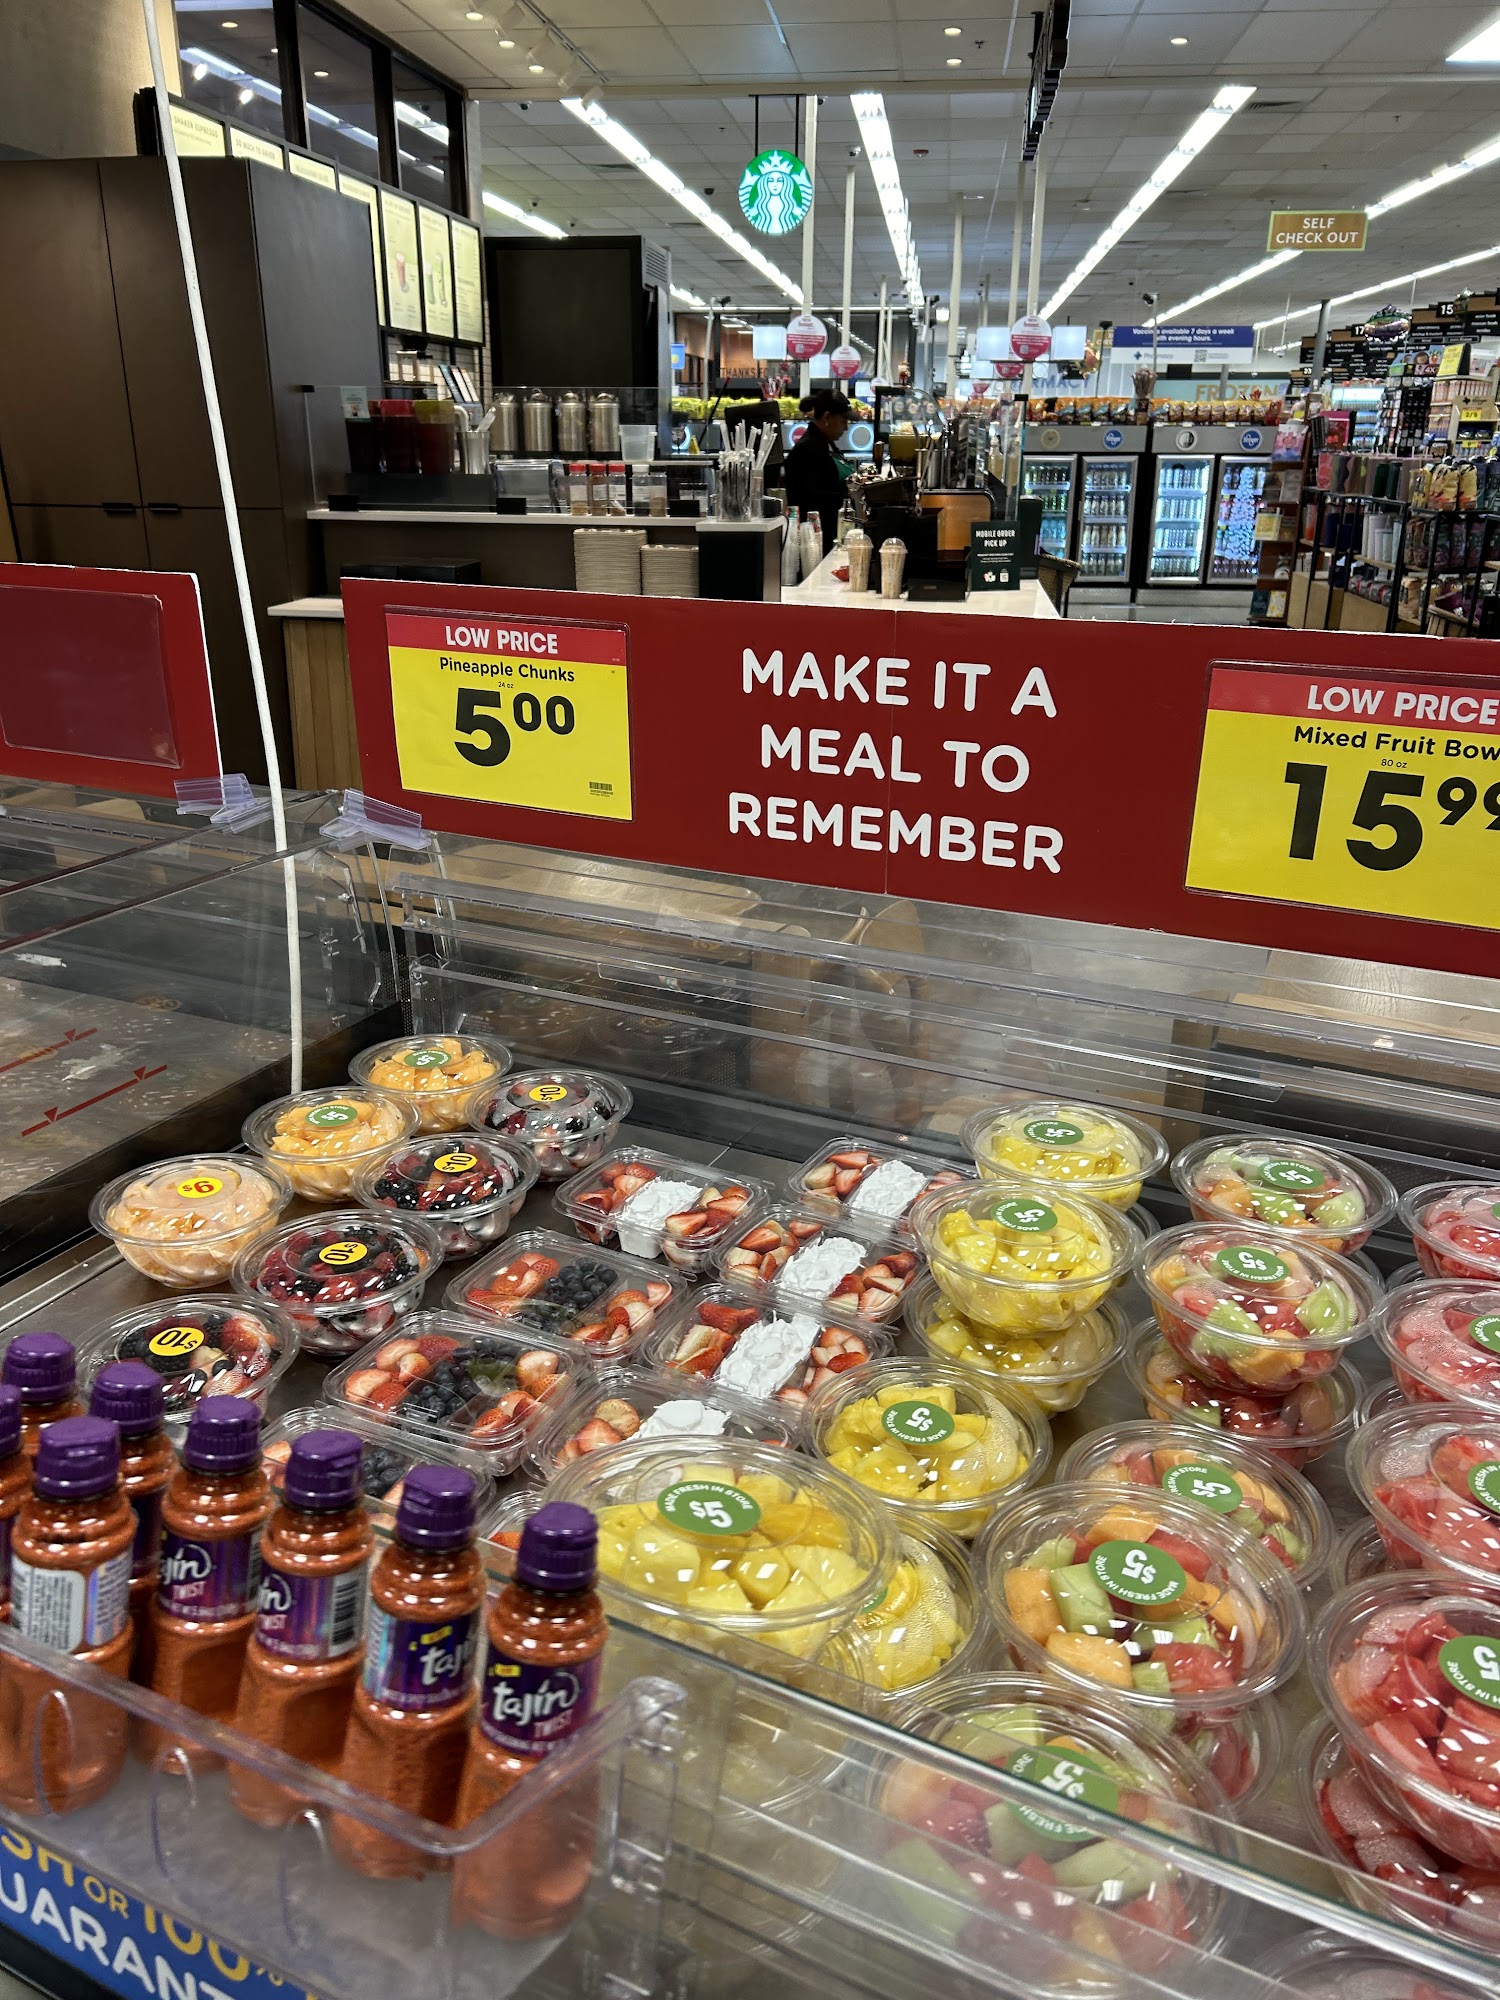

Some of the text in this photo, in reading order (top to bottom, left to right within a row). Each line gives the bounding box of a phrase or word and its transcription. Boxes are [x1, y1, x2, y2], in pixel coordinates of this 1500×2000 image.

[1302, 217, 1335, 229] SELF
[1276, 232, 1358, 244] CHECK OUT
[1440, 304, 1454, 315] 15
[1196, 328, 1212, 336] days
[1355, 326, 1365, 335] 17
[720, 368, 756, 378] THANKS
[1106, 433, 1121, 445] Kroger
[1243, 434, 1260, 446] Kroger
[976, 530, 1016, 538] MOBILE ORDER
[984, 540, 998, 548] PICK
[446, 626, 558, 654] LOW PRICE
[440, 656, 575, 682] Pineapple Chunks
[742, 648, 1057, 718] MAKE IT A
[1307, 684, 1500, 726] LOW PRICE
[1294, 725, 1367, 749] Mixed
[1375, 733, 1436, 755] Fruit
[761, 724, 1030, 792] MEAL TO
[1381, 758, 1394, 768] 80
[728, 792, 1064, 874] REMEMBER
[416, 1055, 436, 1066] $5
[540, 1086, 560, 1101] $10
[321, 1111, 348, 1120] $5
[1044, 1128, 1076, 1138] $5
[442, 1156, 472, 1170] $10
[1290, 1162, 1314, 1172] STORE
[1278, 1170, 1314, 1184] $5
[182, 1181, 214, 1193] $6
[996, 1202, 1018, 1212] STORE
[1014, 1208, 1046, 1222] $5
[324, 1244, 358, 1260] $10
[1222, 1260, 1240, 1274] STORE
[1238, 1252, 1267, 1270] $5
[157, 1330, 198, 1350] $10
[886, 1410, 898, 1428] STORE
[906, 1408, 934, 1431] $5
[898, 1432, 926, 1442] FRESH
[926, 1429, 948, 1442] MADE
[1171, 1470, 1181, 1478] IN
[1178, 1466, 1208, 1474] STORE
[1475, 1468, 1490, 1491] FRESH
[1190, 1480, 1232, 1498] $5
[664, 1484, 754, 1512] MADE FRESH IN STORE
[1480, 1491, 1500, 1510] ADE
[688, 1500, 732, 1528] $5
[1121, 1549, 1156, 1584] $5
[1096, 1555, 1180, 1600] MADE FRESH IN STORE
[172, 1581, 207, 1600] TWIST
[1473, 1646, 1500, 1680] 5
[1447, 1661, 1490, 1700] IN STORE
[493, 1672, 580, 1726] tajín
[534, 1708, 574, 1737] TWIST
[1012, 1752, 1034, 1773] ORE
[1040, 1760, 1086, 1798] $5
[83, 1876, 130, 1919] OR
